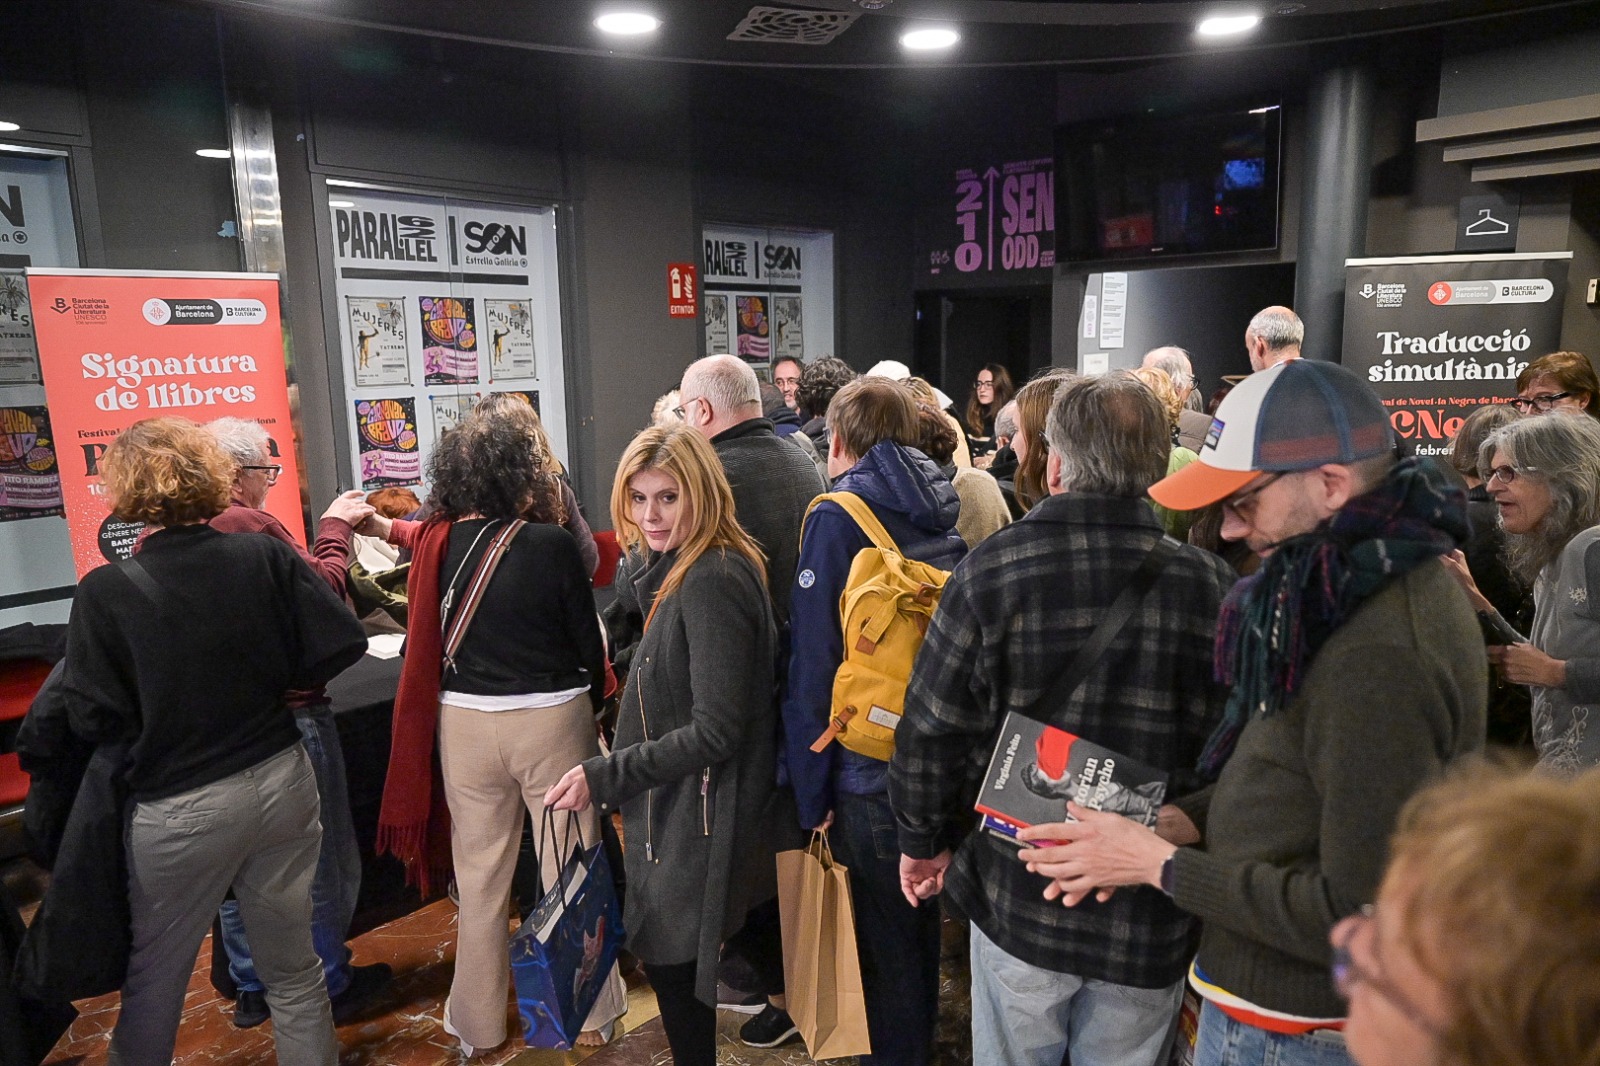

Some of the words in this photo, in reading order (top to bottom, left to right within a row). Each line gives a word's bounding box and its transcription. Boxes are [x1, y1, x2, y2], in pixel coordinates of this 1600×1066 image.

[465, 256, 493, 266] Estrella
[494, 257, 519, 267] Galicia
[176, 310, 215, 318] Barcelona
[671, 305, 695, 314] EXTINTOR
[352, 307, 404, 341] MUJERES
[488, 308, 531, 339] MUJERES
[1376, 328, 1531, 355] Traducció
[81, 353, 258, 389] Signatura
[95, 386, 139, 411] de
[146, 382, 256, 409] llibres
[1396, 398, 1407, 406] de
[1449, 397, 1477, 408] Negra
[1478, 396, 1490, 404] de
[436, 405, 462, 420] MUJE
[111, 538, 137, 547] BARCE
[994, 756, 1014, 790] Virginia
[1006, 733, 1021, 756] Feito
[1088, 758, 1115, 812] Psycho
